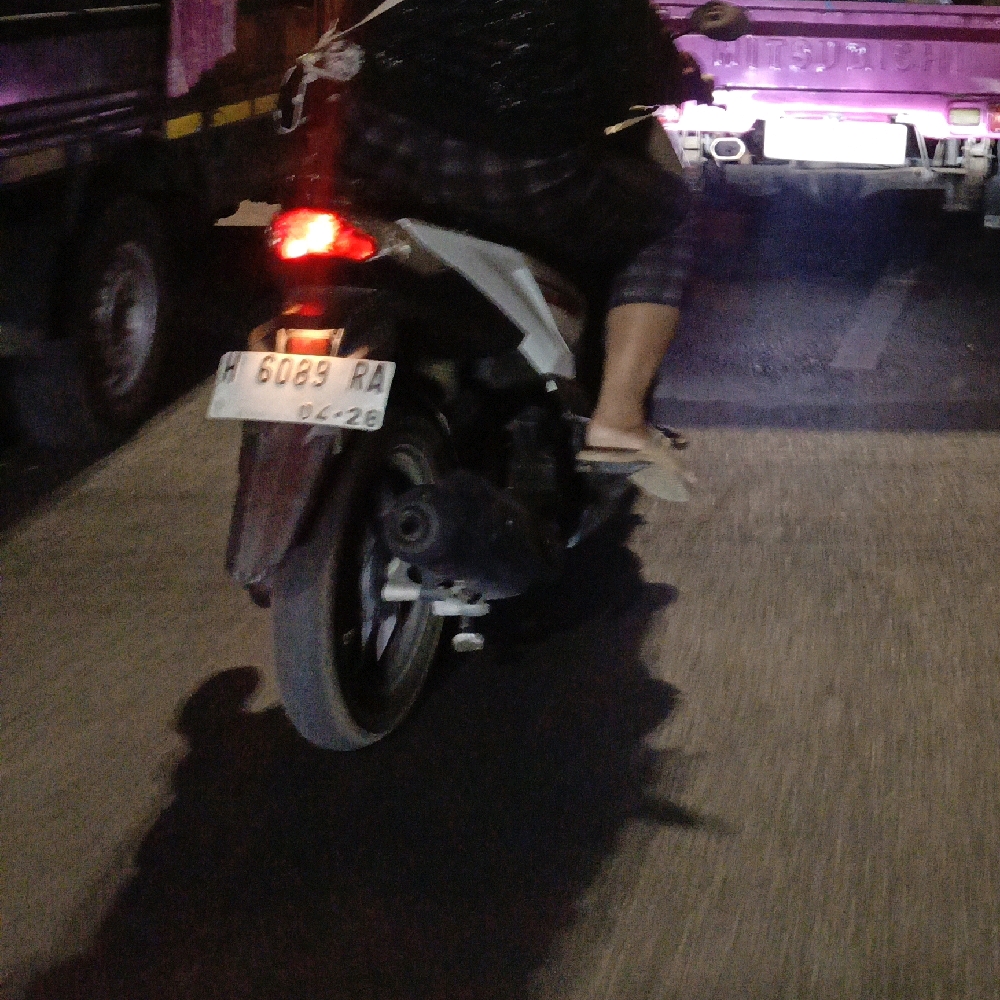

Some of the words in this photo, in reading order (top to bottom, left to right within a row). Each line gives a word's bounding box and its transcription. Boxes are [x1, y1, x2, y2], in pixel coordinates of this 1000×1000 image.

[221, 351, 242, 384] H
[256, 354, 331, 388] 6089
[348, 360, 387, 395] RA
